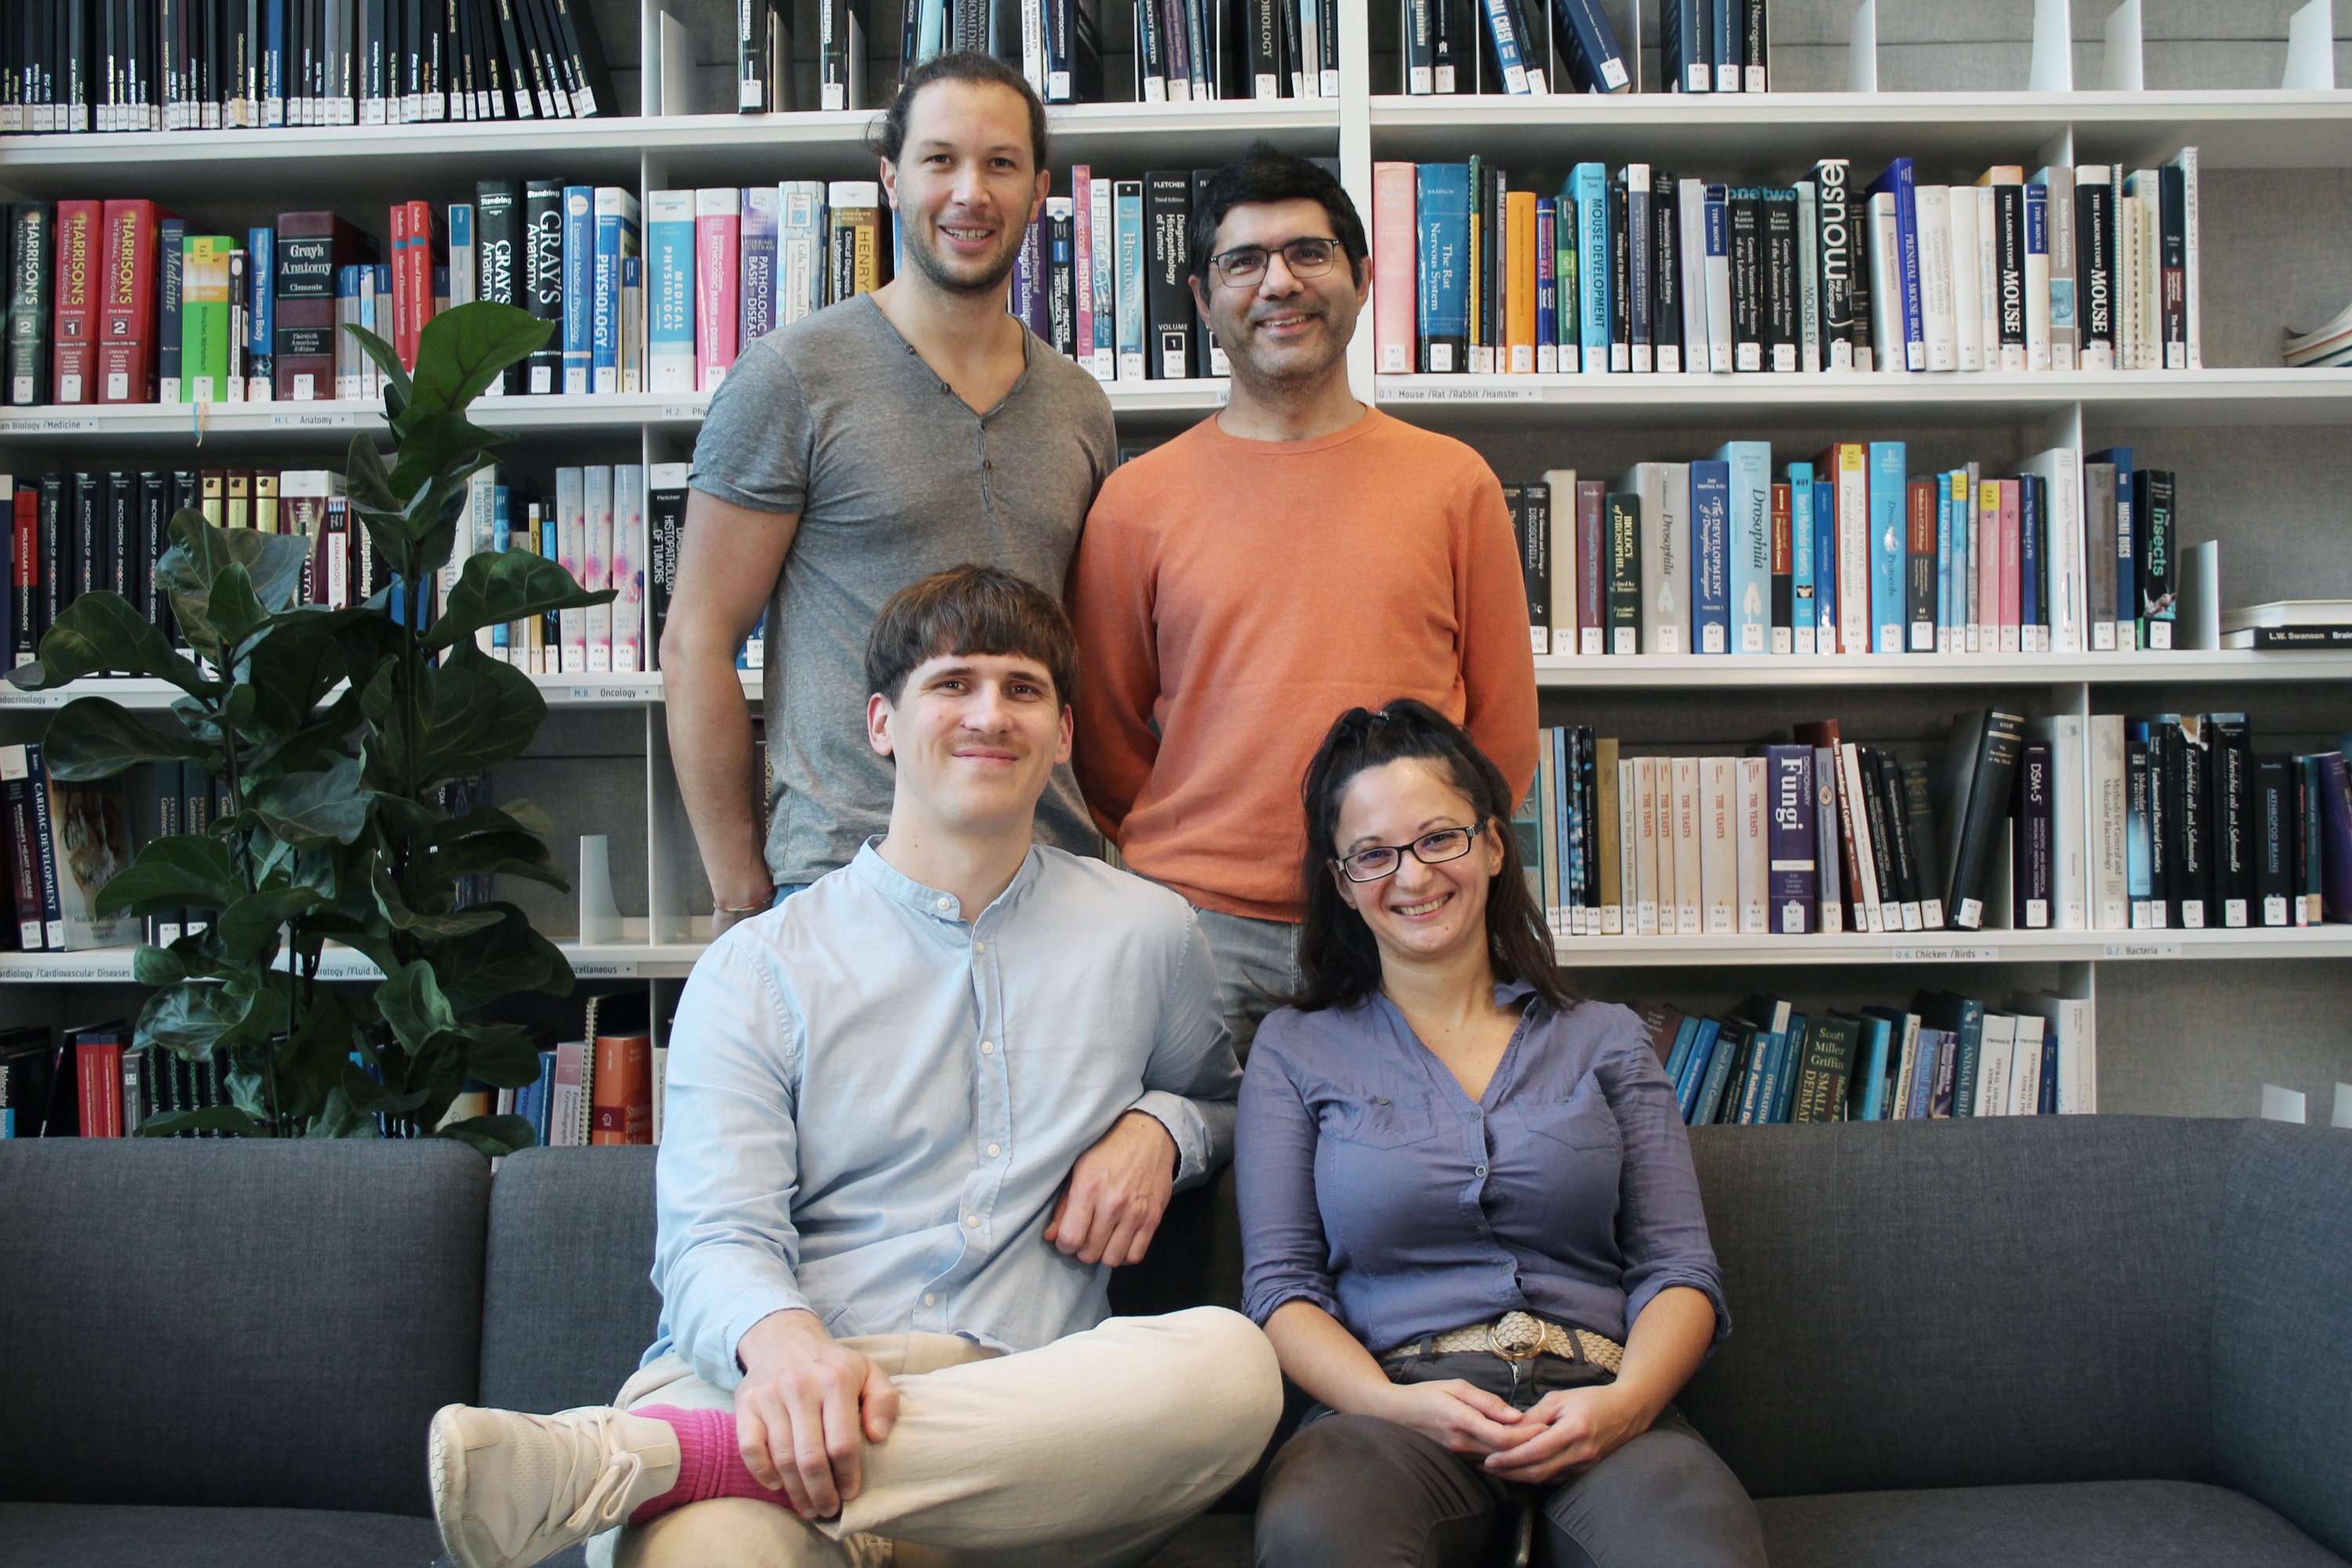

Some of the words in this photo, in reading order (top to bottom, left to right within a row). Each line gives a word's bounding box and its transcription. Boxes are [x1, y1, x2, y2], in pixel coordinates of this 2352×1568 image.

[1492, 16, 1515, 43] CREST
[1147, 34, 1158, 65] PROTEIN
[481, 197, 512, 205] Standring
[528, 189, 560, 198] Standring
[1077, 210, 1087, 256] Functional
[1156, 214, 1165, 225] of
[1592, 198, 1603, 241] MOUSE
[1663, 208, 1672, 248] Manipulating
[1711, 207, 1720, 225] THE
[1821, 164, 1848, 280] mouse
[573, 222, 583, 260] Essential
[844, 230, 853, 257] Clinical
[1030, 223, 1039, 245] Theory
[1156, 226, 1165, 261] Tumors
[1165, 213, 1176, 285] Histopathology
[1176, 214, 1185, 263] Diagnostic
[1430, 222, 1440, 268] Nervous
[1736, 237, 1744, 245] of
[1783, 238, 1791, 265] Genetic
[2005, 212, 2014, 269] LABORATORY
[2093, 212, 2102, 268] LABORATORY
[24, 220, 41, 305] HARRISON'S
[71, 220, 86, 306] HARRISON'S
[119, 219, 136, 304] HARRISON'S
[281, 261, 332, 276] Anatomy
[495, 239, 512, 305] GRAY'S
[526, 223, 539, 293] Anatomy
[539, 210, 562, 305] GRAY'S
[748, 256, 758, 286] BASIS
[1123, 232, 1136, 303] HISTOLOGY
[1443, 243, 1452, 267] The
[1539, 260, 1548, 279] RAT
[1905, 233, 1915, 281] PRENATAL
[166, 247, 182, 312] Medicine
[256, 270, 265, 282] The
[290, 283, 322, 292] Clemente
[573, 261, 583, 295] Medical
[663, 245, 673, 331] PHYSIOLOGY
[843, 259, 853, 294] Diagnosis
[1079, 258, 1090, 313] HISTOLOGY
[1428, 270, 1440, 310] System
[1443, 268, 1452, 289] Rat
[1593, 245, 1605, 328] DEVELOPMENT
[1783, 267, 1791, 296] Variants
[1889, 259, 1897, 290] Genetics
[255, 287, 265, 319] Human
[596, 254, 609, 348] PHYSIOLOGY
[674, 271, 684, 330] MEDICAL
[757, 256, 768, 332] PATHOLOGIC
[1804, 285, 1815, 328] MOUSE
[1907, 283, 1917, 316] MOUSE
[2003, 269, 2020, 334] MOUSE
[2091, 269, 2108, 334] MOUSE
[20, 321, 31, 334] 2
[67, 322, 76, 335] 1
[114, 321, 125, 335] 2
[253, 320, 265, 342] Body
[572, 296, 583, 343] Physiology
[747, 298, 758, 343] DISEASE
[1399, 390, 1425, 399] Mouse
[13, 420, 40, 430] Biology
[43, 419, 80, 430] /Medicine
[300, 416, 332, 426] Anatomy
[484, 486, 492, 528] MALIGNANT
[2118, 502, 2131, 535] IMAGINAL
[653, 529, 663, 543] OF
[1528, 507, 1538, 570] DROSOPHILA
[1624, 515, 1633, 558] BIOLOGY
[1660, 514, 1673, 575] Drosophila
[1748, 488, 1767, 568] Drosophila
[2153, 507, 2167, 576] Insects
[653, 544, 664, 583] TUMORS
[1711, 518, 1722, 597] DEVELOPMENT
[2288, 632, 2325, 641] Swanson
[601, 688, 636, 698] Oncology
[34, 782, 47, 830] CARDIAC
[1775, 757, 1803, 831] Fungi
[2112, 778, 2122, 813] Methods
[2113, 815, 2122, 826] for
[2269, 788, 2278, 840] ARTHROPOD
[2113, 827, 2122, 858] General
[2270, 843, 2279, 873] BRAINS
[40, 833, 56, 912] DEVELOPMENT
[2114, 860, 2122, 875] and
[1915, 949, 1947, 958] Chicken
[2125, 946, 2158, 955] Bacteria
[36, 968, 94, 978] /Cardiovascular
[98, 967, 130, 977] Diseases
[1815, 1042, 1846, 1055] Miller
[1819, 1027, 1845, 1041] Scott
[1751, 1041, 1766, 1070] Small
[1810, 1054, 1845, 1069] Griffin
[1960, 1044, 1973, 1087] ANIMAL
[1744, 1073, 1760, 1109] Animal
[1813, 1072, 1831, 1116] SMALL
